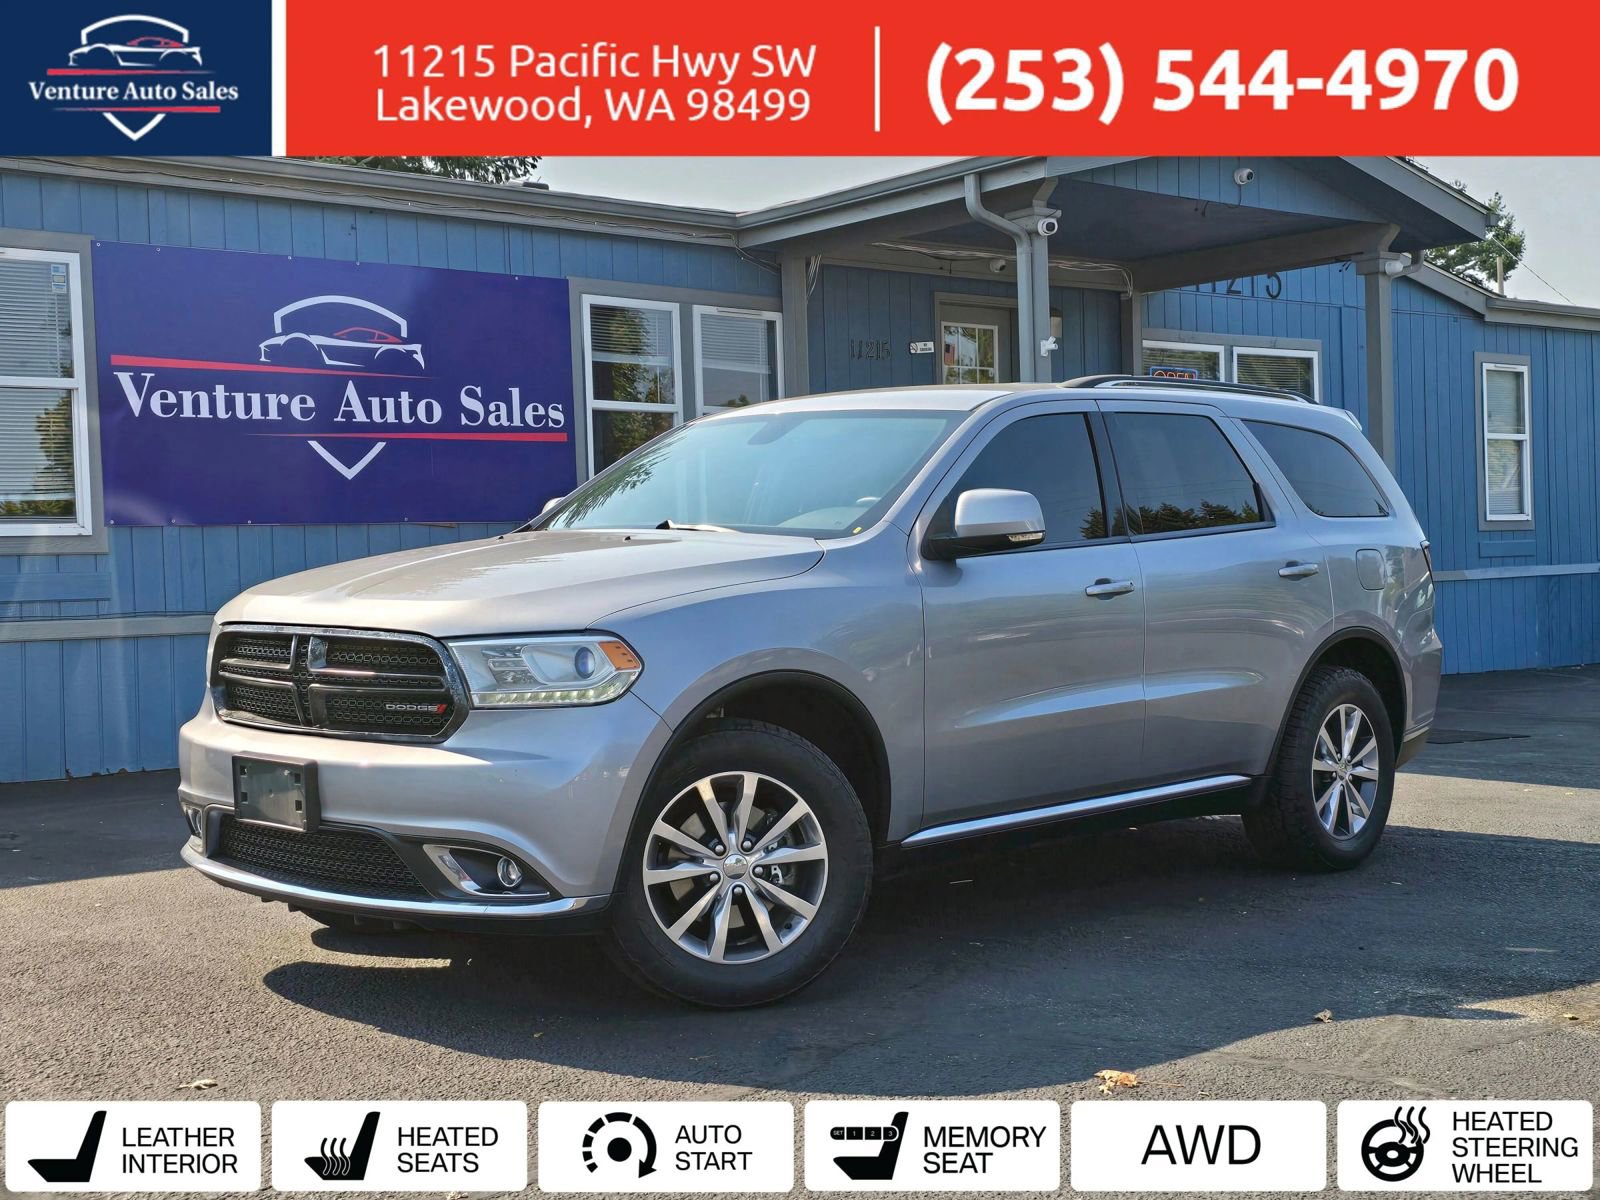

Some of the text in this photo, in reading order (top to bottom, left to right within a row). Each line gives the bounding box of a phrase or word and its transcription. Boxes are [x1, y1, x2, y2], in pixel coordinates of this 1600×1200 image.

[113, 371, 565, 427] Venture Auto Sales
[385, 704, 438, 712] DODGE
